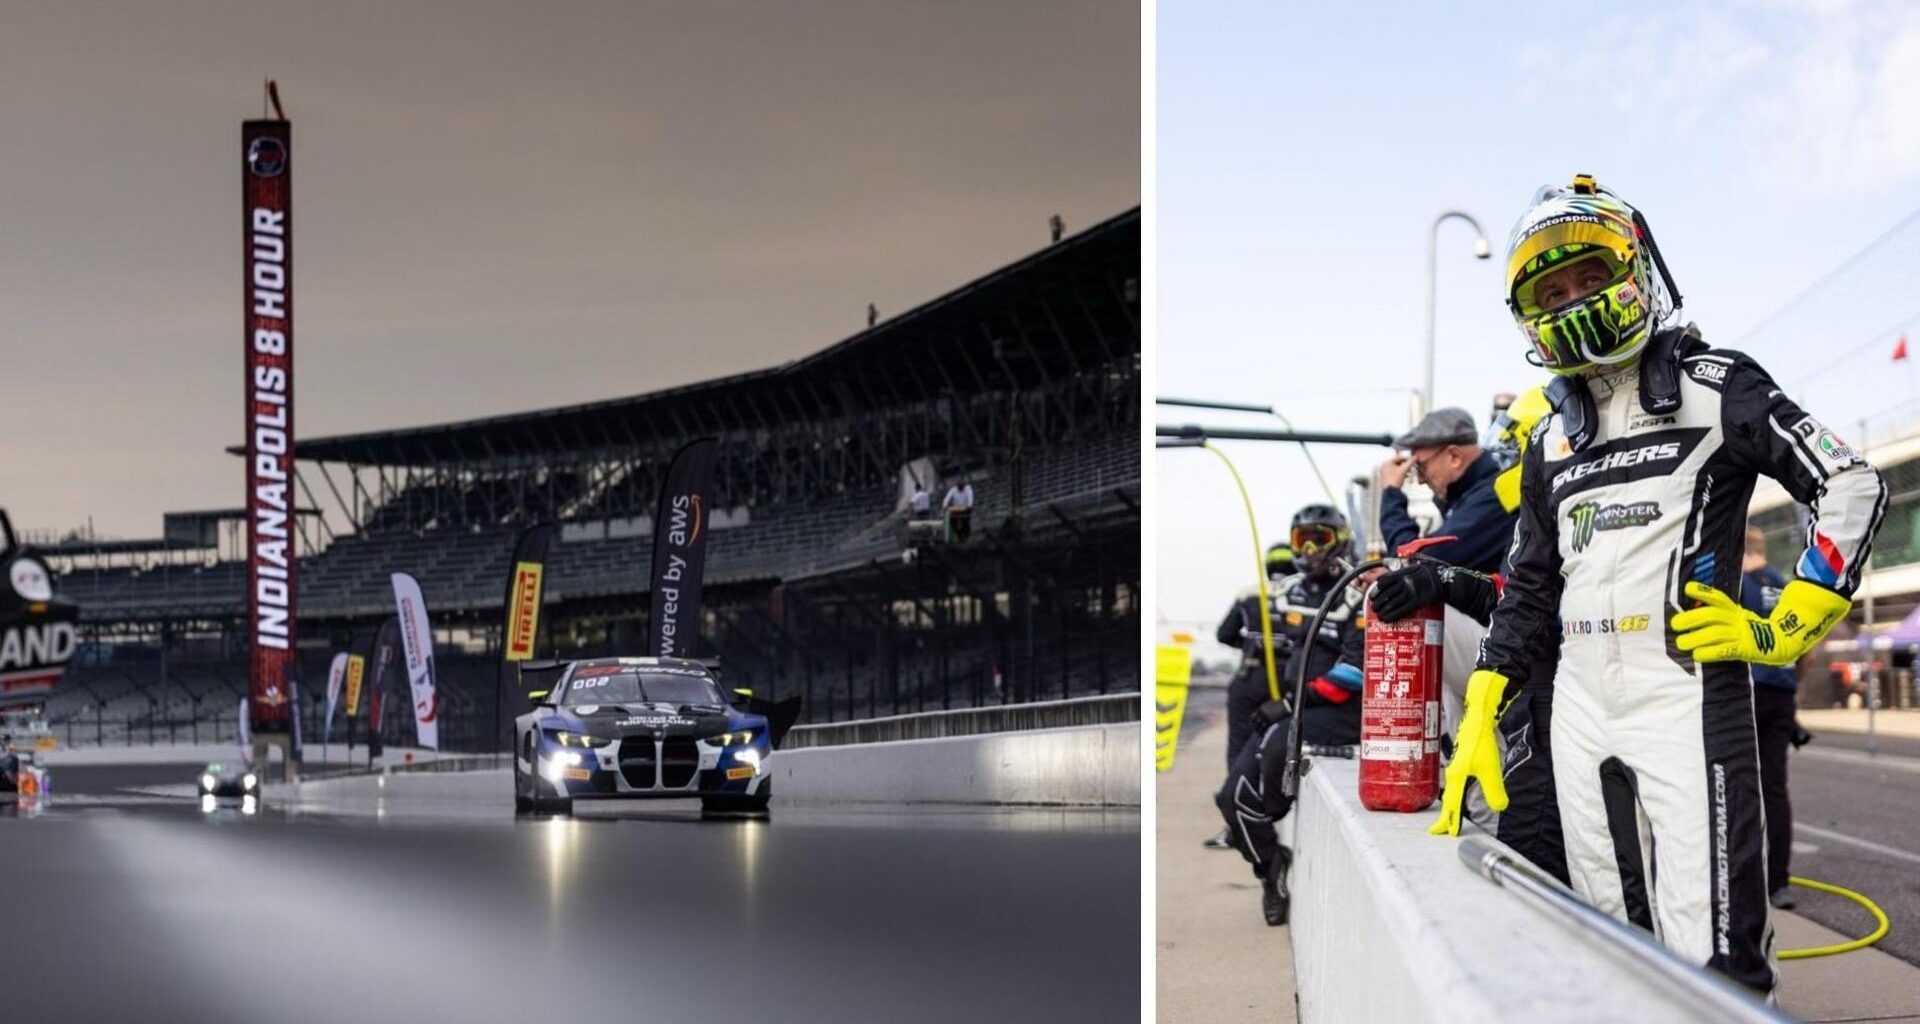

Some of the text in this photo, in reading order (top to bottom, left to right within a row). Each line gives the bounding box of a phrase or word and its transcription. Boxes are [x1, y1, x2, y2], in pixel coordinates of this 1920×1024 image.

[1528, 214, 1600, 236] Motorsport
[1619, 301, 1641, 327] 46
[1693, 363, 1727, 381] OMP
[253, 207, 289, 649] INDIANAPOLIS 8 HOUR
[1552, 442, 1681, 494] SKECHERS
[669, 495, 690, 545] aws
[663, 555, 686, 581] by
[511, 570, 538, 652] PIRELLI
[1713, 763, 1731, 956] W-RACINGTEAM.COM
